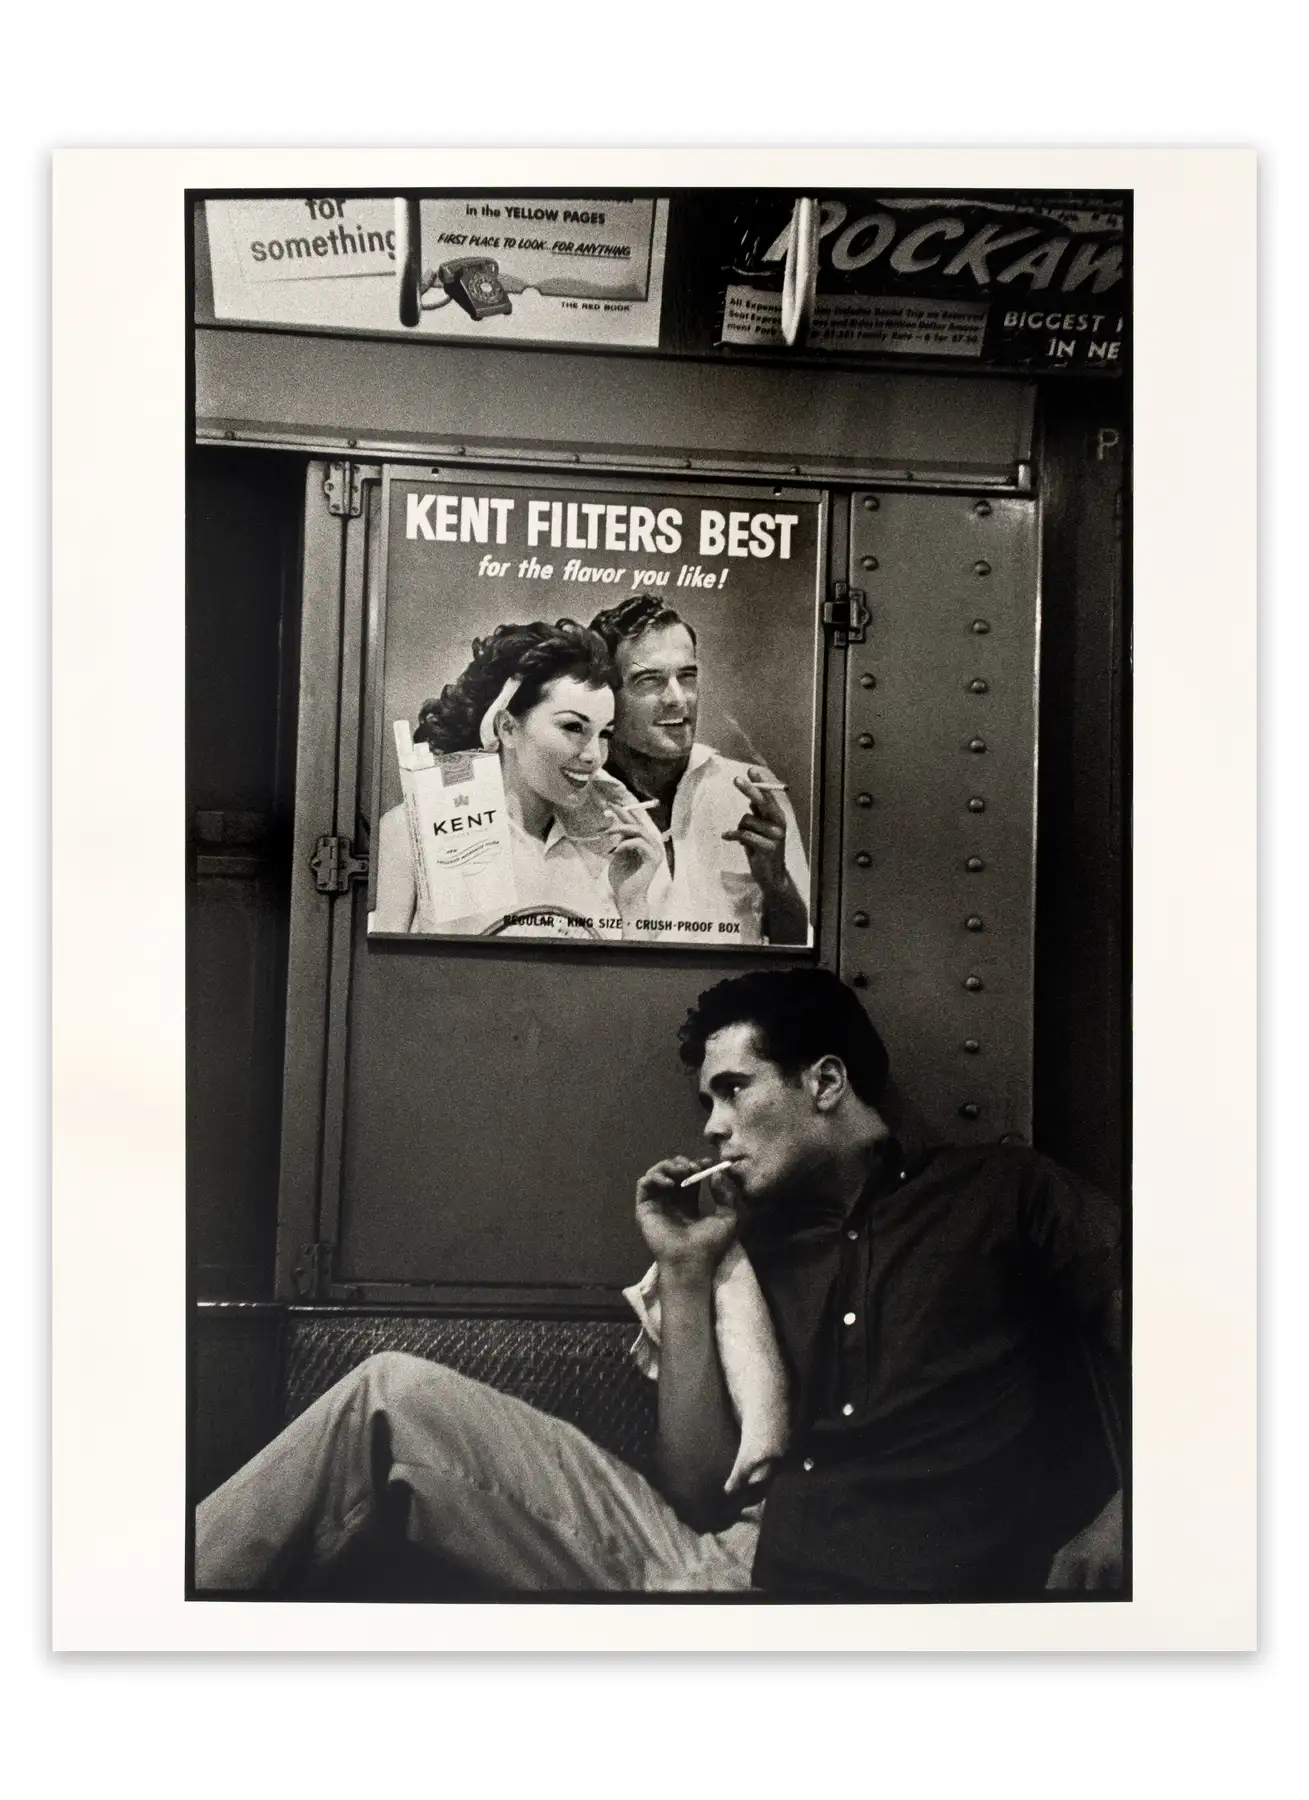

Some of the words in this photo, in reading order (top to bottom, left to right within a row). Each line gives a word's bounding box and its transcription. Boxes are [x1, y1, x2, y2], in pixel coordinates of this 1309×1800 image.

[304, 199, 347, 220] for
[466, 204, 478, 216] in
[481, 205, 500, 217] the
[504, 206, 558, 221] YELLOW
[563, 210, 606, 225] PAGES
[250, 225, 396, 262] something
[437, 232, 468, 245] FIRST
[469, 234, 501, 248] PLACE
[503, 238, 517, 248] TO
[551, 241, 575, 254] FOR
[574, 243, 631, 257] ANYTHING
[561, 301, 578, 309] THE
[581, 303, 600, 311] RED
[603, 304, 630, 312] BOOK
[1003, 311, 1106, 333] BIGGEST
[1048, 338, 1076, 358] IN
[1087, 341, 1122, 361] NE
[1097, 428, 1120, 461] P
[406, 493, 514, 544] KENT
[527, 499, 683, 554] FILTERS
[700, 509, 799, 560] BEST
[478, 553, 511, 578] for
[518, 556, 554, 580] the
[563, 558, 626, 585] flavor
[631, 569, 669, 591] you
[676, 565, 729, 590] like!
[433, 810, 497, 837] KENT
[503, 914, 555, 928] REGULAR
[567, 916, 594, 929] KING
[598, 918, 624, 930] SIZE
[635, 918, 713, 933] CRUSH-PROOF
[718, 921, 741, 934] BOX
